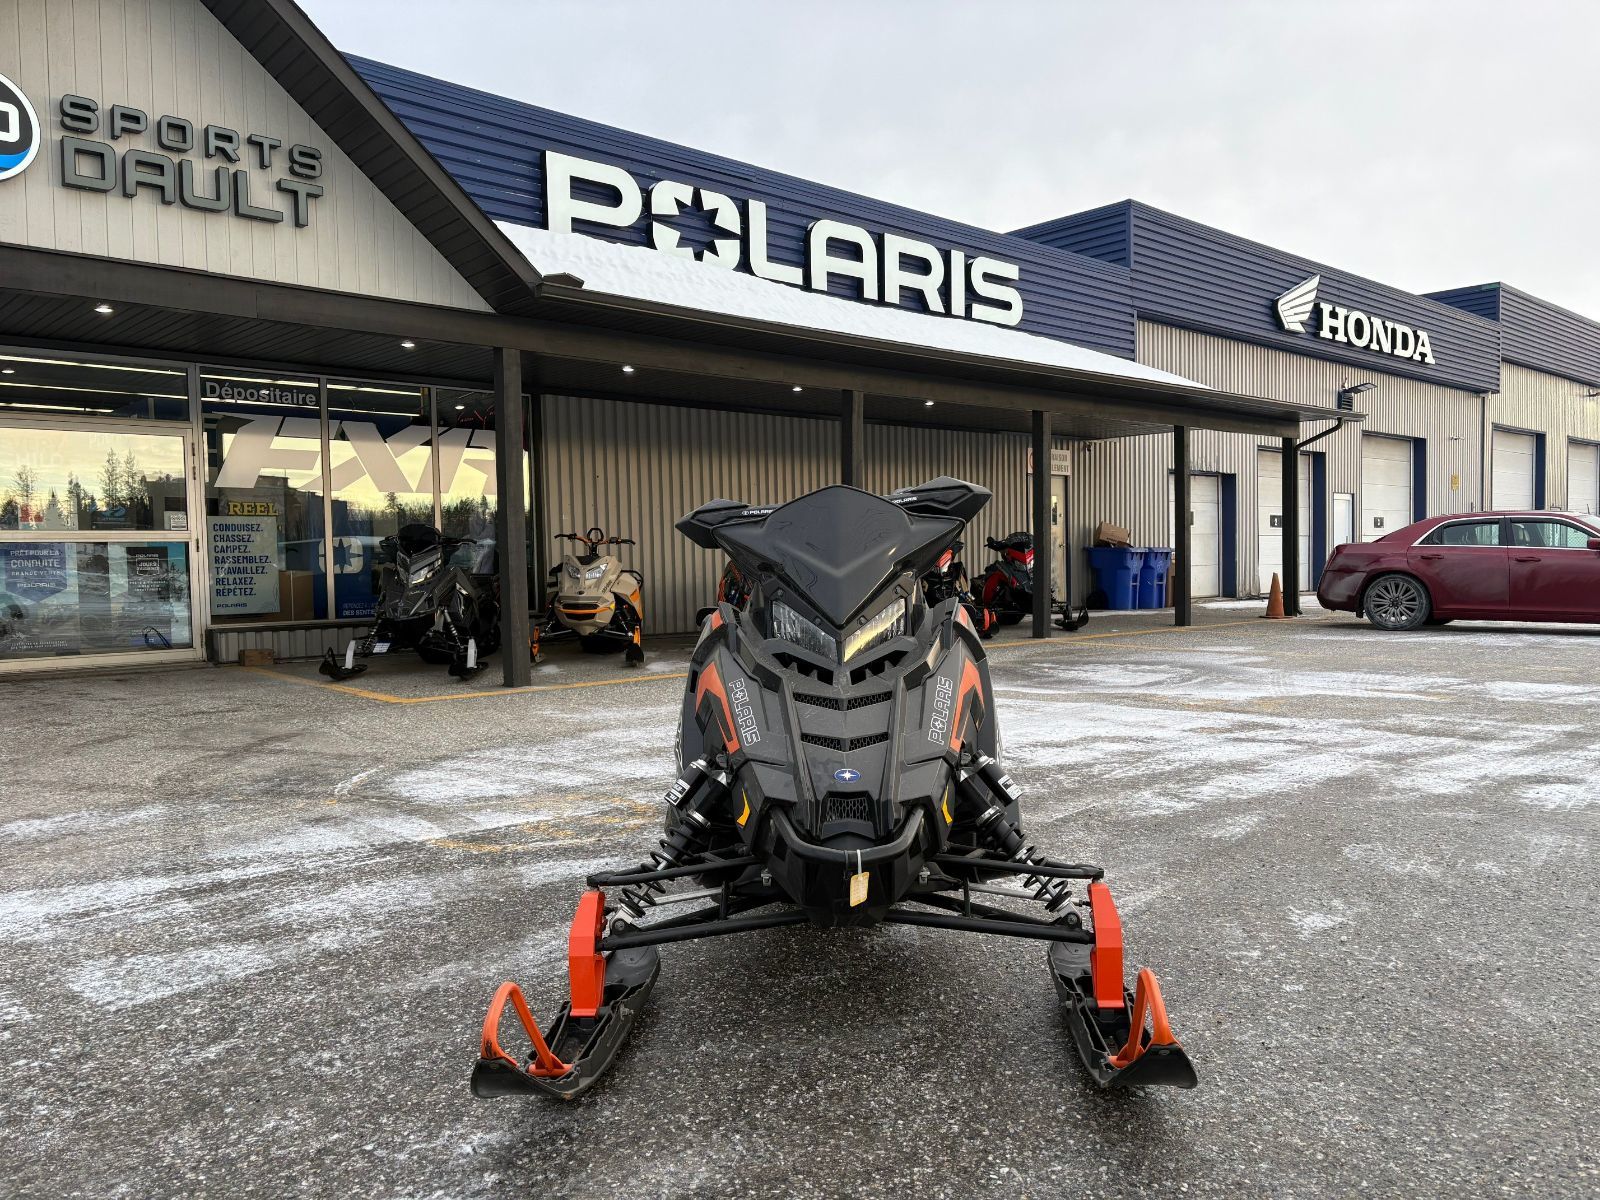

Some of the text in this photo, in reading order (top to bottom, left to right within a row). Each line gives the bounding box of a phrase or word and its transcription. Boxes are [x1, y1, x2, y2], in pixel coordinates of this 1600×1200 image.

[60, 94, 323, 179] SPORTS
[60, 135, 324, 228] DAULT
[544, 150, 1024, 327] POLARIS
[1318, 302, 1436, 364] HONDA
[205, 381, 317, 406] Dépositaire
[228, 502, 279, 516] REEL
[213, 523, 264, 532] CONDUISEZ.
[213, 534, 255, 543] CHASSEZ.
[214, 544, 251, 554] CAMPEZ.
[10, 559, 61, 568] CONDUITE
[214, 555, 272, 564] RASSEMBLEZ.
[215, 566, 268, 575] TRAVAILLEZ.
[215, 577, 257, 586] RELAXEZ.
[216, 586, 257, 597] RÉPÉTEZ.
[729, 677, 761, 746] POLARIS
[928, 676, 953, 746] POLARIS
